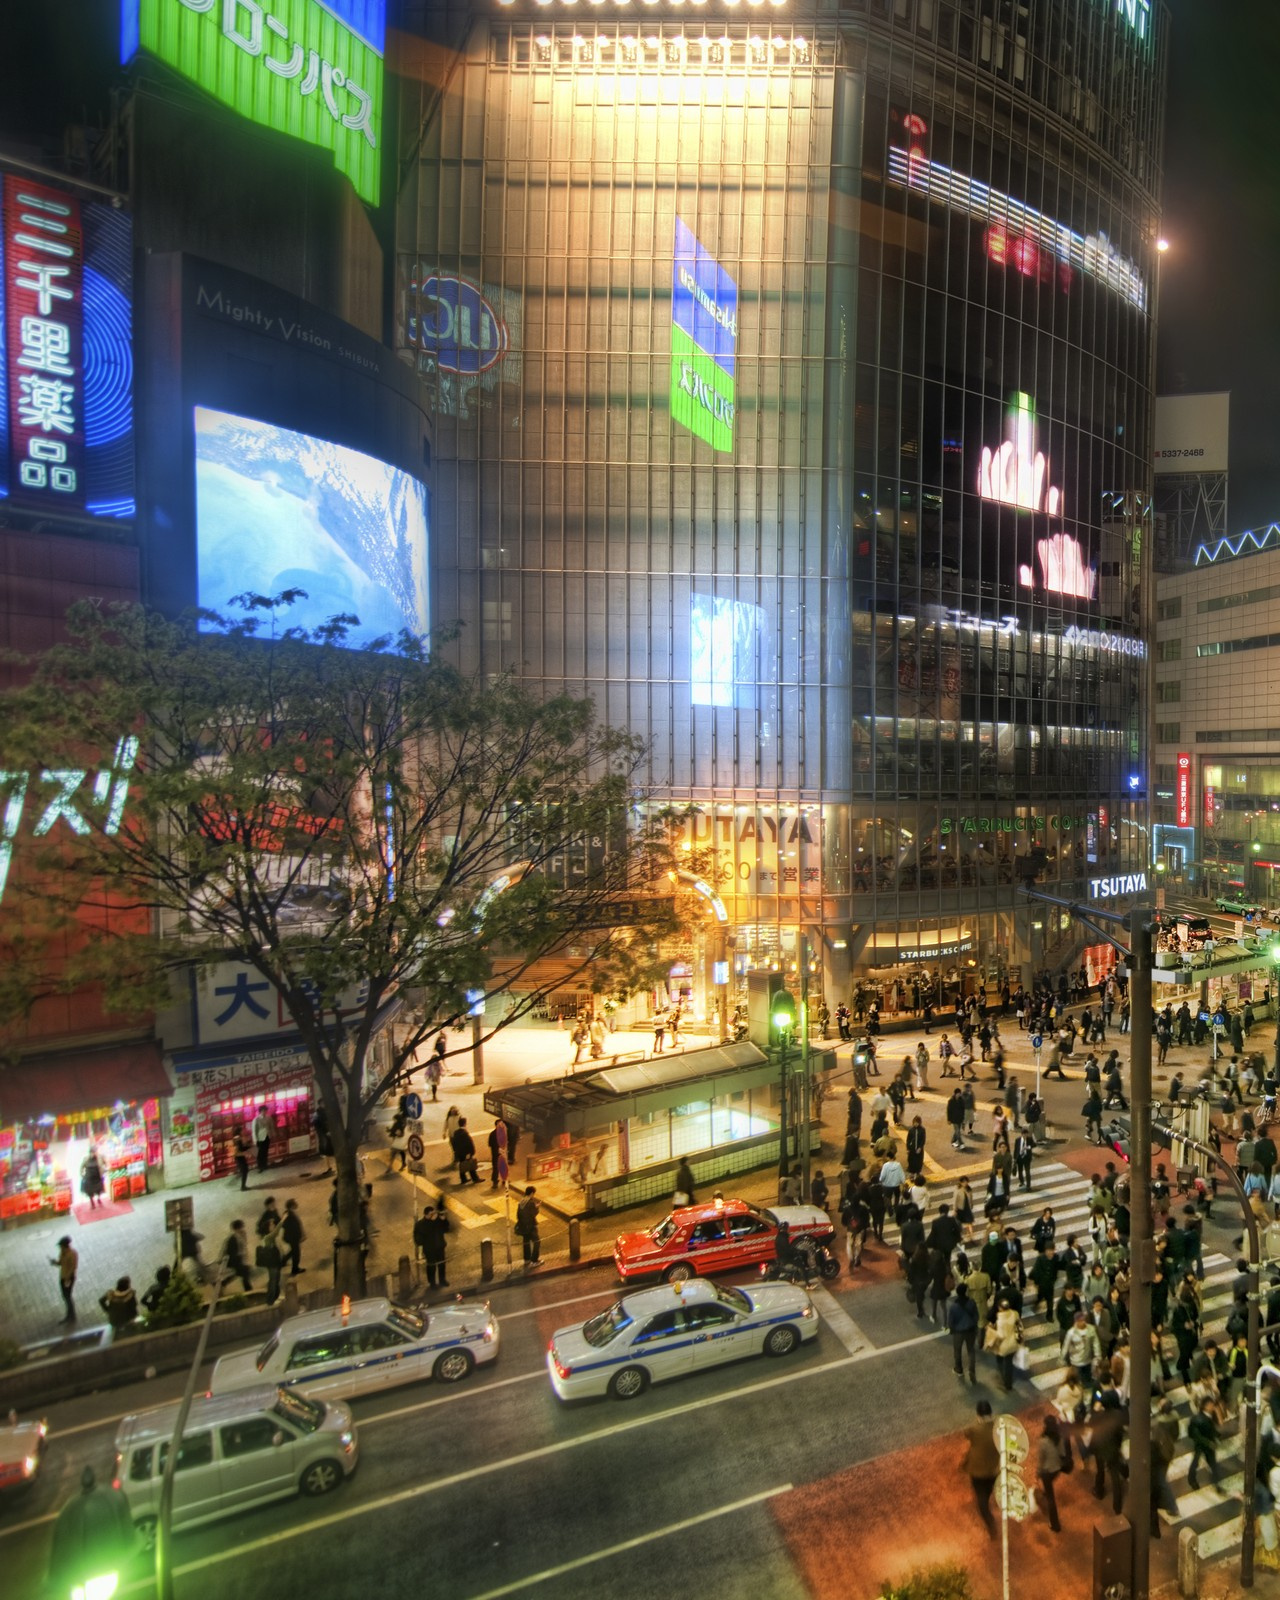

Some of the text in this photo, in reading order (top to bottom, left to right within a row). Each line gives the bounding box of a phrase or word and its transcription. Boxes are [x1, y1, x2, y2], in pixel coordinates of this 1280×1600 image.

[178, 0, 376, 149] ロンパス
[13, 194, 77, 493] 三千里薬品
[196, 285, 380, 373] Mighty Vision SHIBUYA
[1091, 873, 1147, 898] TSUTAYA
[236, 1048, 295, 1063] TAISEIDO
